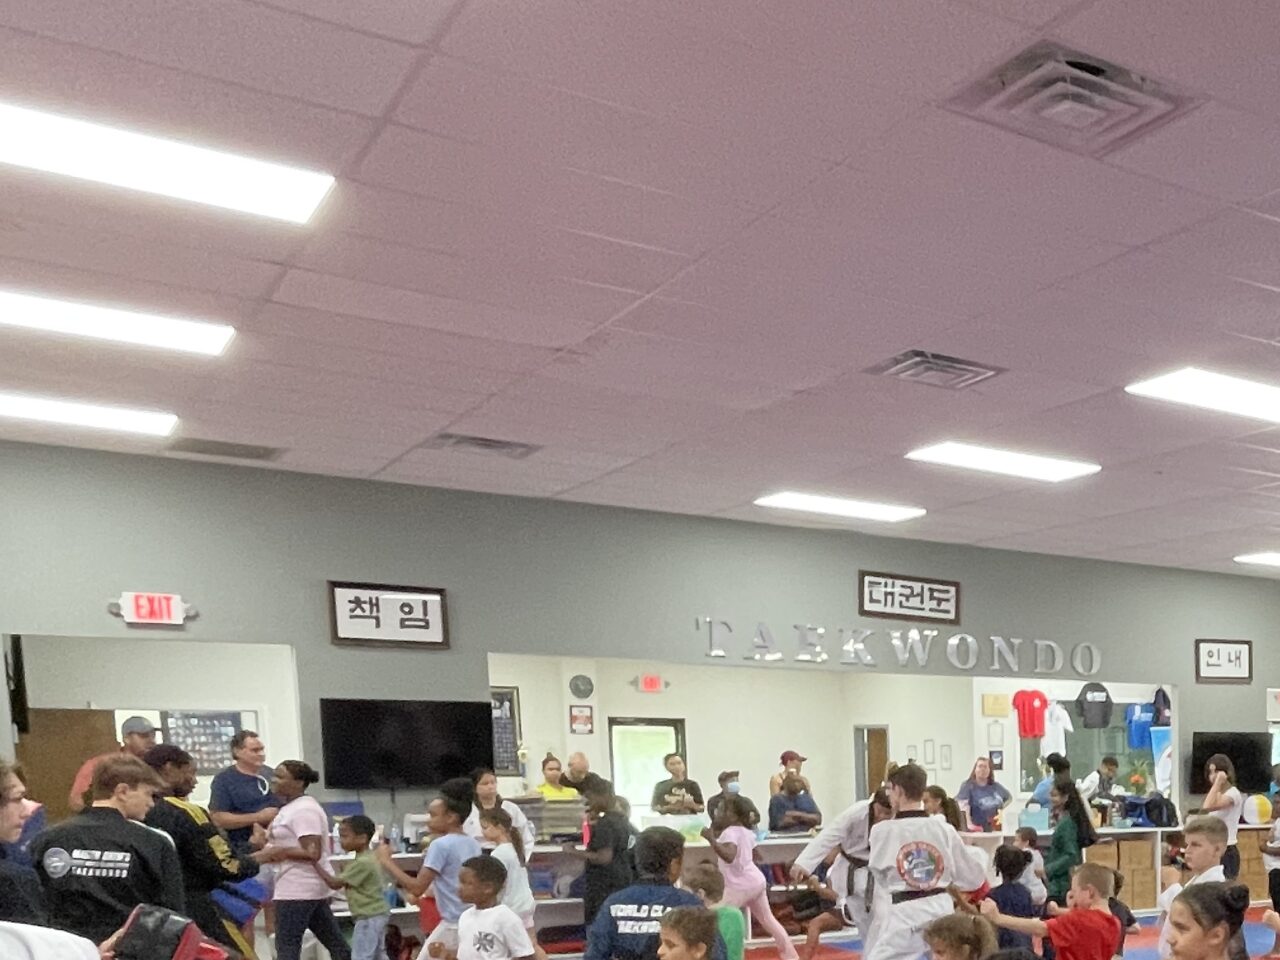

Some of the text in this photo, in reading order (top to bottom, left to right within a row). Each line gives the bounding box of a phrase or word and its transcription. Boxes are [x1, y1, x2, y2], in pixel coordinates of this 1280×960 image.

[134, 594, 173, 620] EXIT
[867, 580, 951, 614] 태권도
[695, 617, 1101, 676] TAEKWONDO
[610, 904, 649, 918] WORLD
